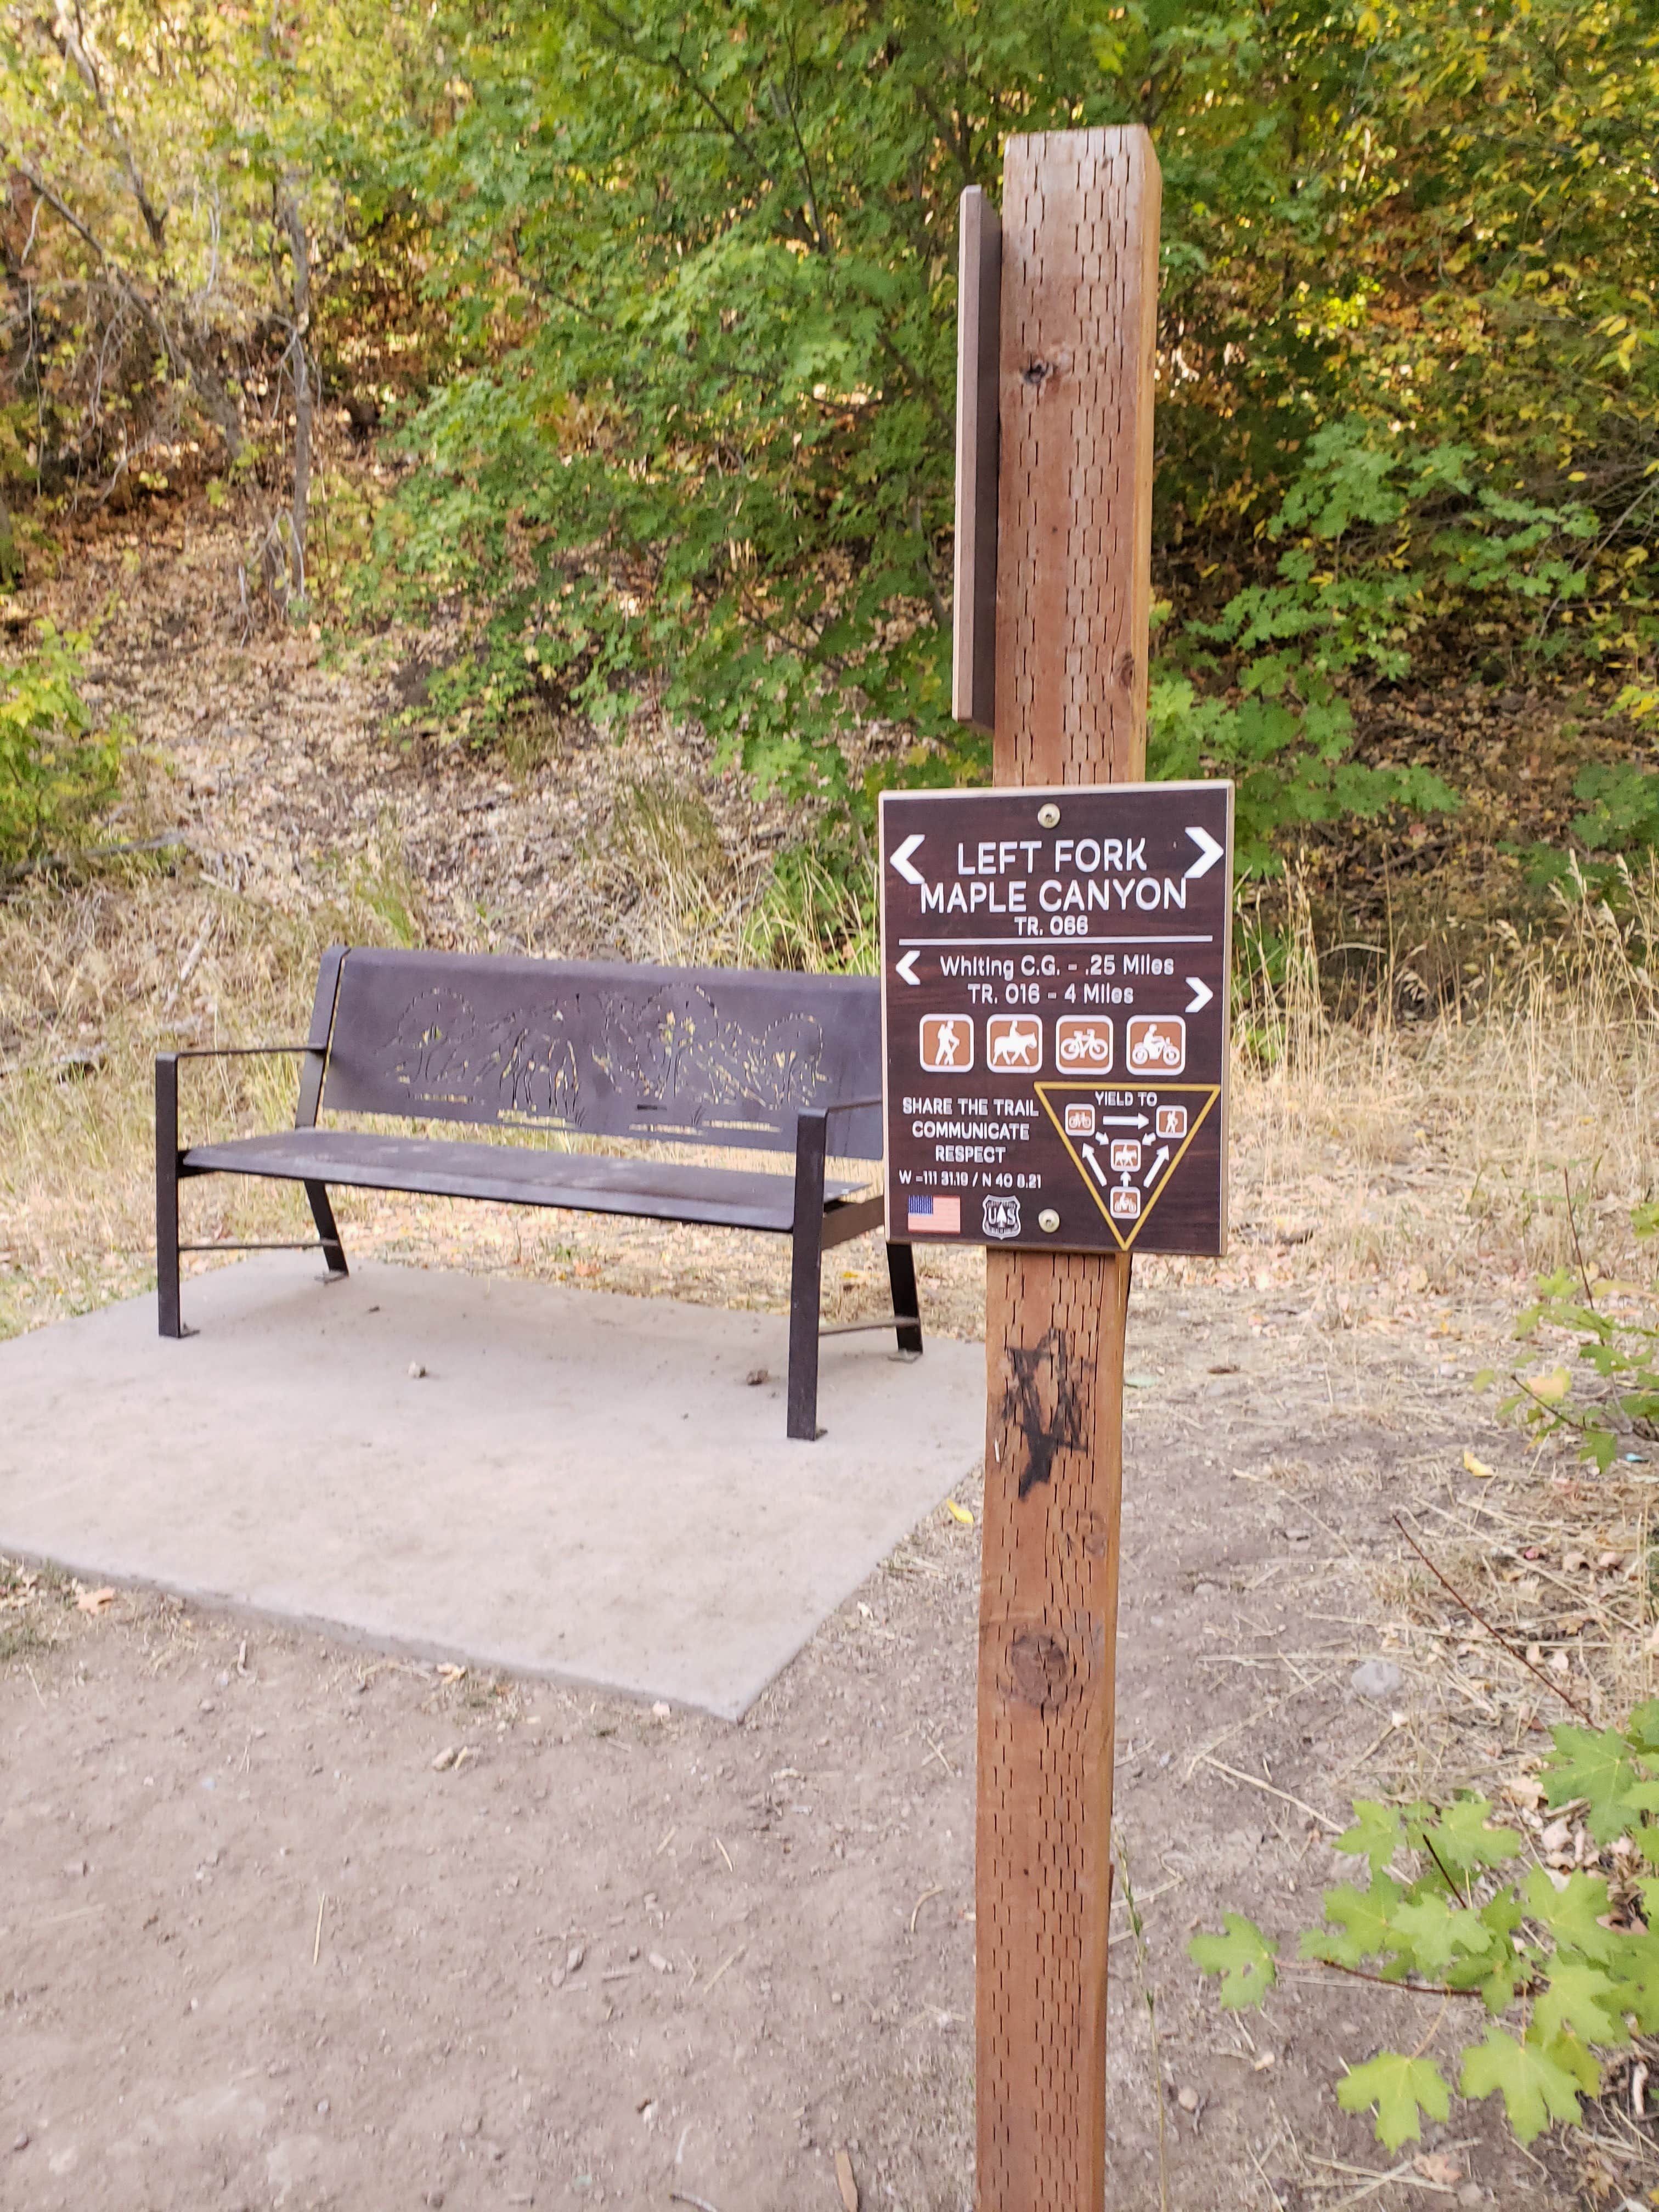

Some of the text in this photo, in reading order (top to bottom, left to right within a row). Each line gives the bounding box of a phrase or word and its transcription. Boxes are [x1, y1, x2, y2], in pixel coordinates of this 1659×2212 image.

[957, 837, 1148, 875] LEFT FORK
[921, 877, 1187, 914] MAPLE CANYON
[1014, 916, 1043, 936] TR.
[940, 955, 1014, 981] Whiting
[1021, 955, 1060, 977] C.G.
[1085, 954, 1115, 975] .25
[1123, 953, 1174, 975] Miles
[967, 983, 997, 1005] TR.
[1005, 983, 1040, 1005] 016
[1064, 983, 1076, 1004] 4
[1084, 982, 1134, 1005] Miles
[902, 1097, 1039, 1117] SHARE THE TRAIL
[1094, 1091, 1158, 1107] YIELD TO
[912, 1120, 1030, 1141] COMMUNICATE
[935, 1144, 1006, 1164] RESPECT
[899, 1169, 912, 1185] W
[972, 1171, 979, 1188] /
[982, 1172, 992, 1188] N
[995, 1172, 1013, 1188] 40
